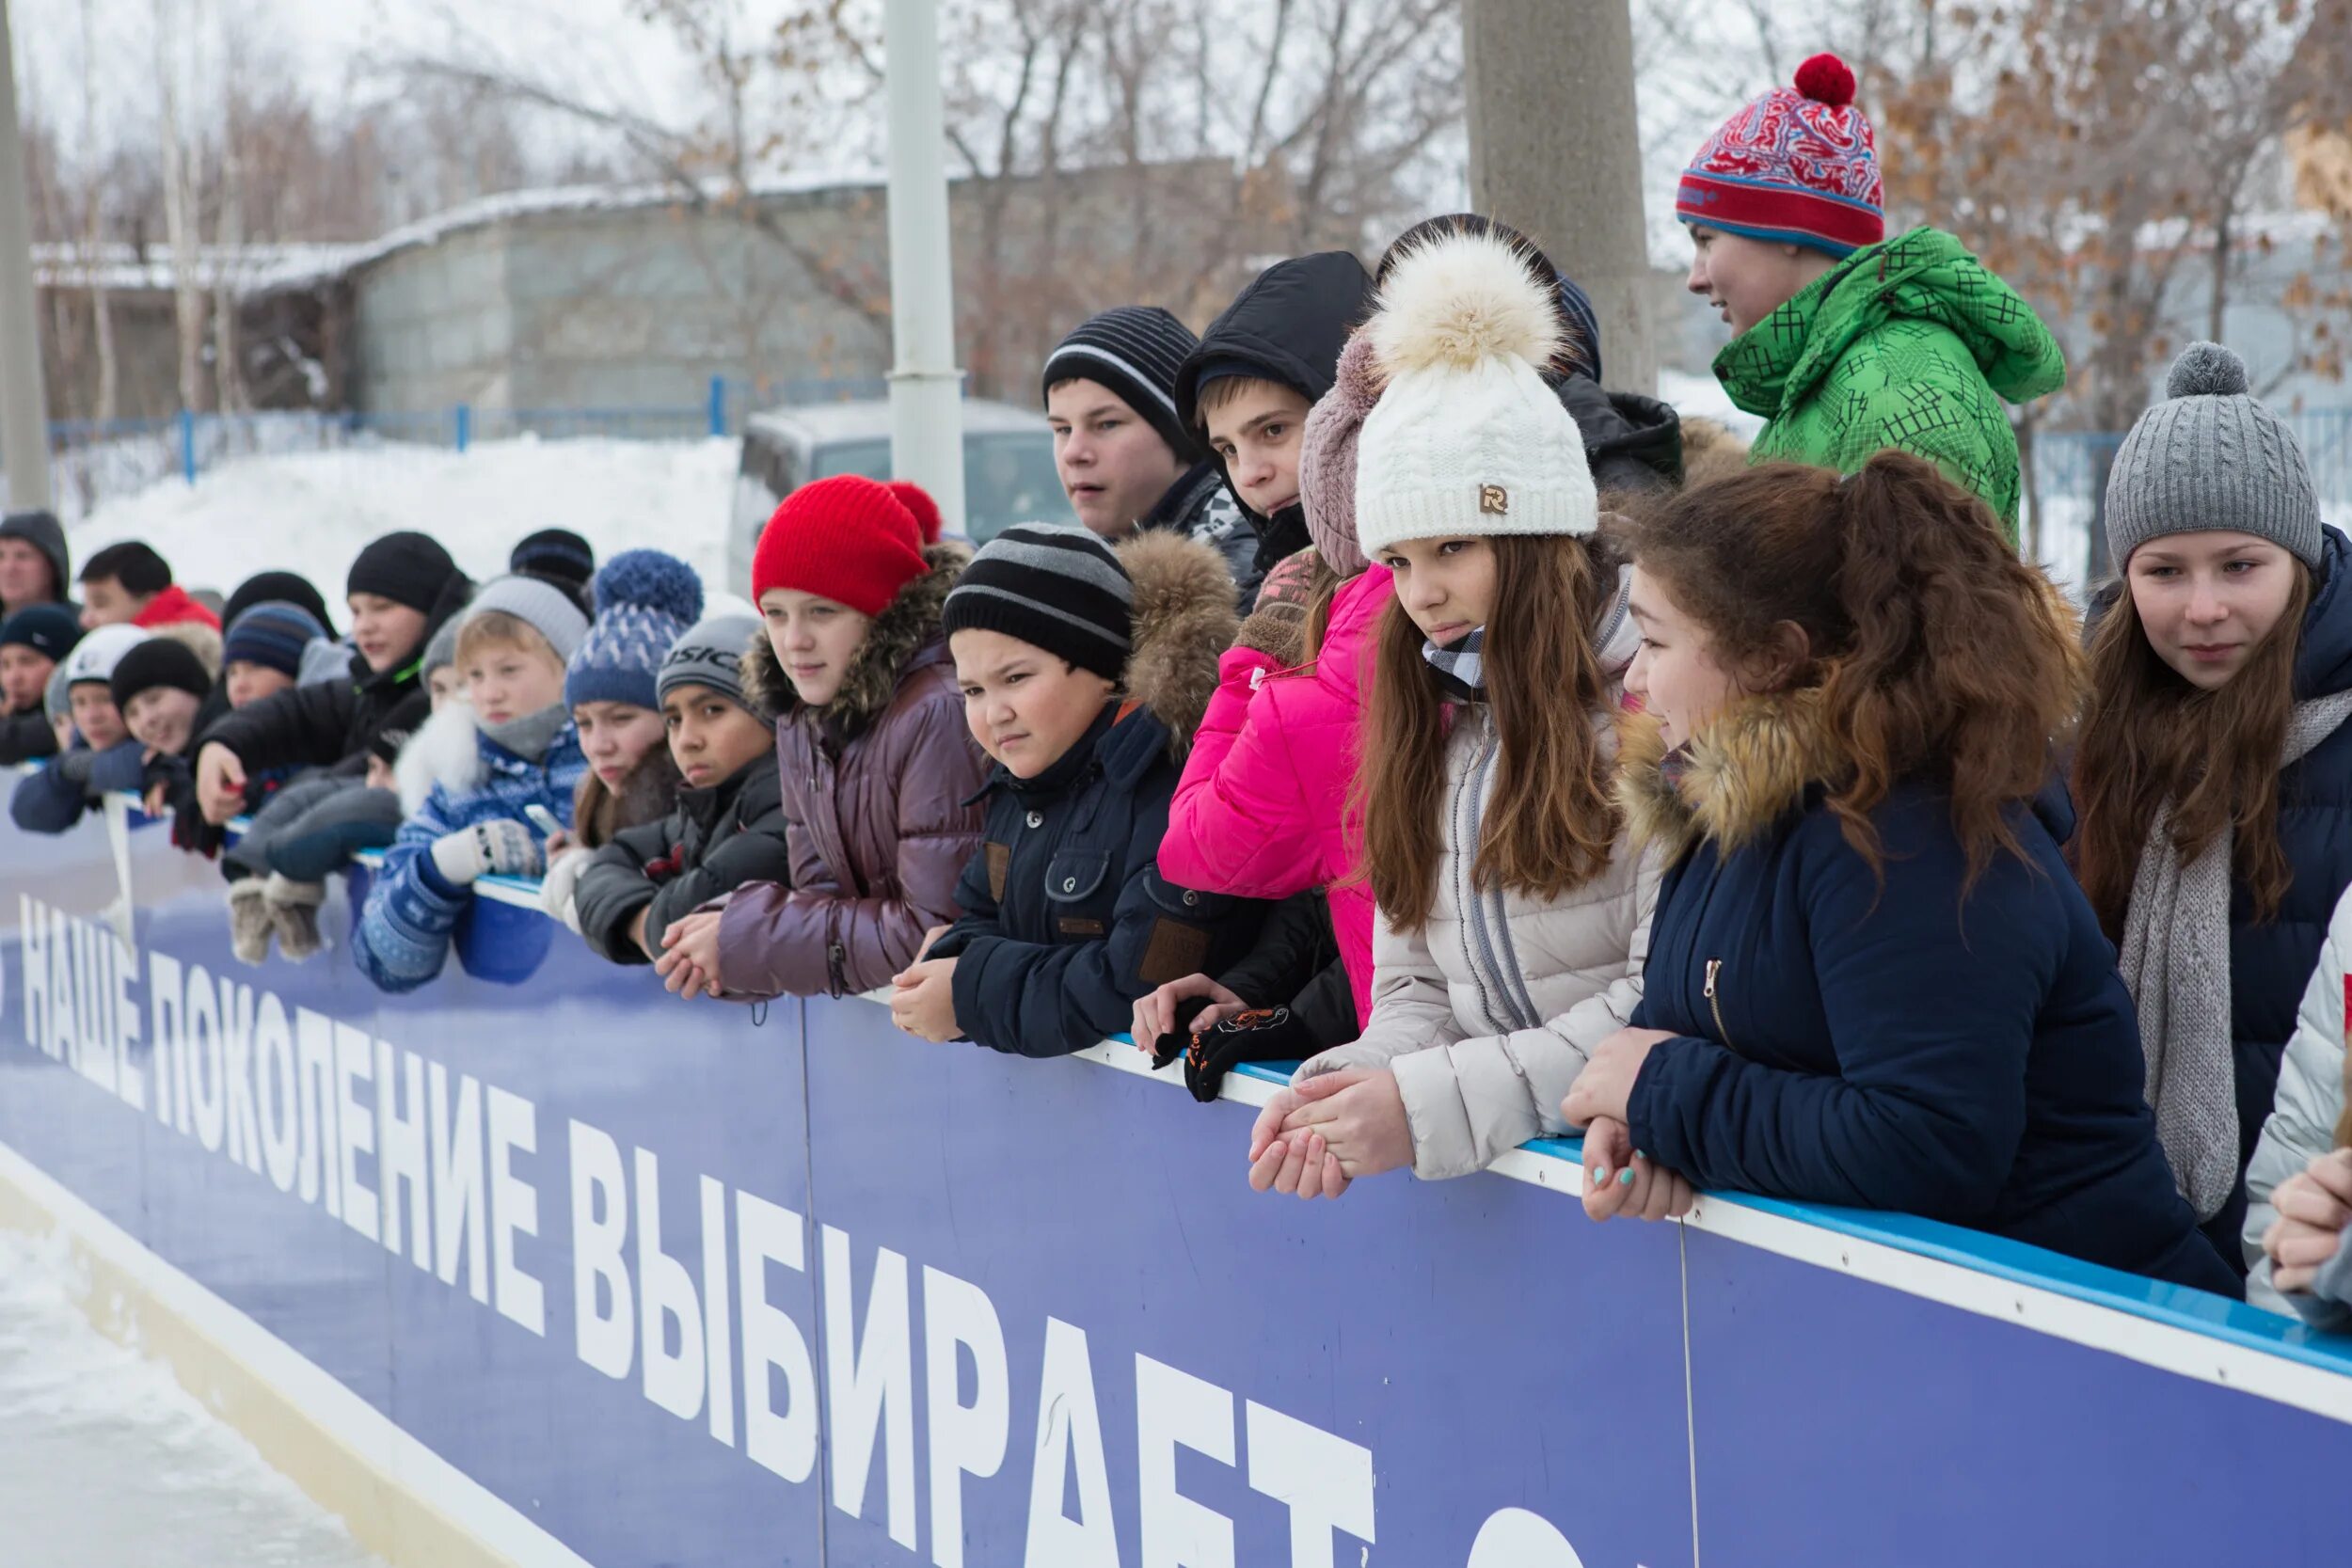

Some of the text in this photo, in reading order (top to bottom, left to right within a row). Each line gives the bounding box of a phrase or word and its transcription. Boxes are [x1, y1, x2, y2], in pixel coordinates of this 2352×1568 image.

[20, 893, 1375, 1568] НАШЕ ПОКОЛЕНИЕ ВЫБИРАЕТ
